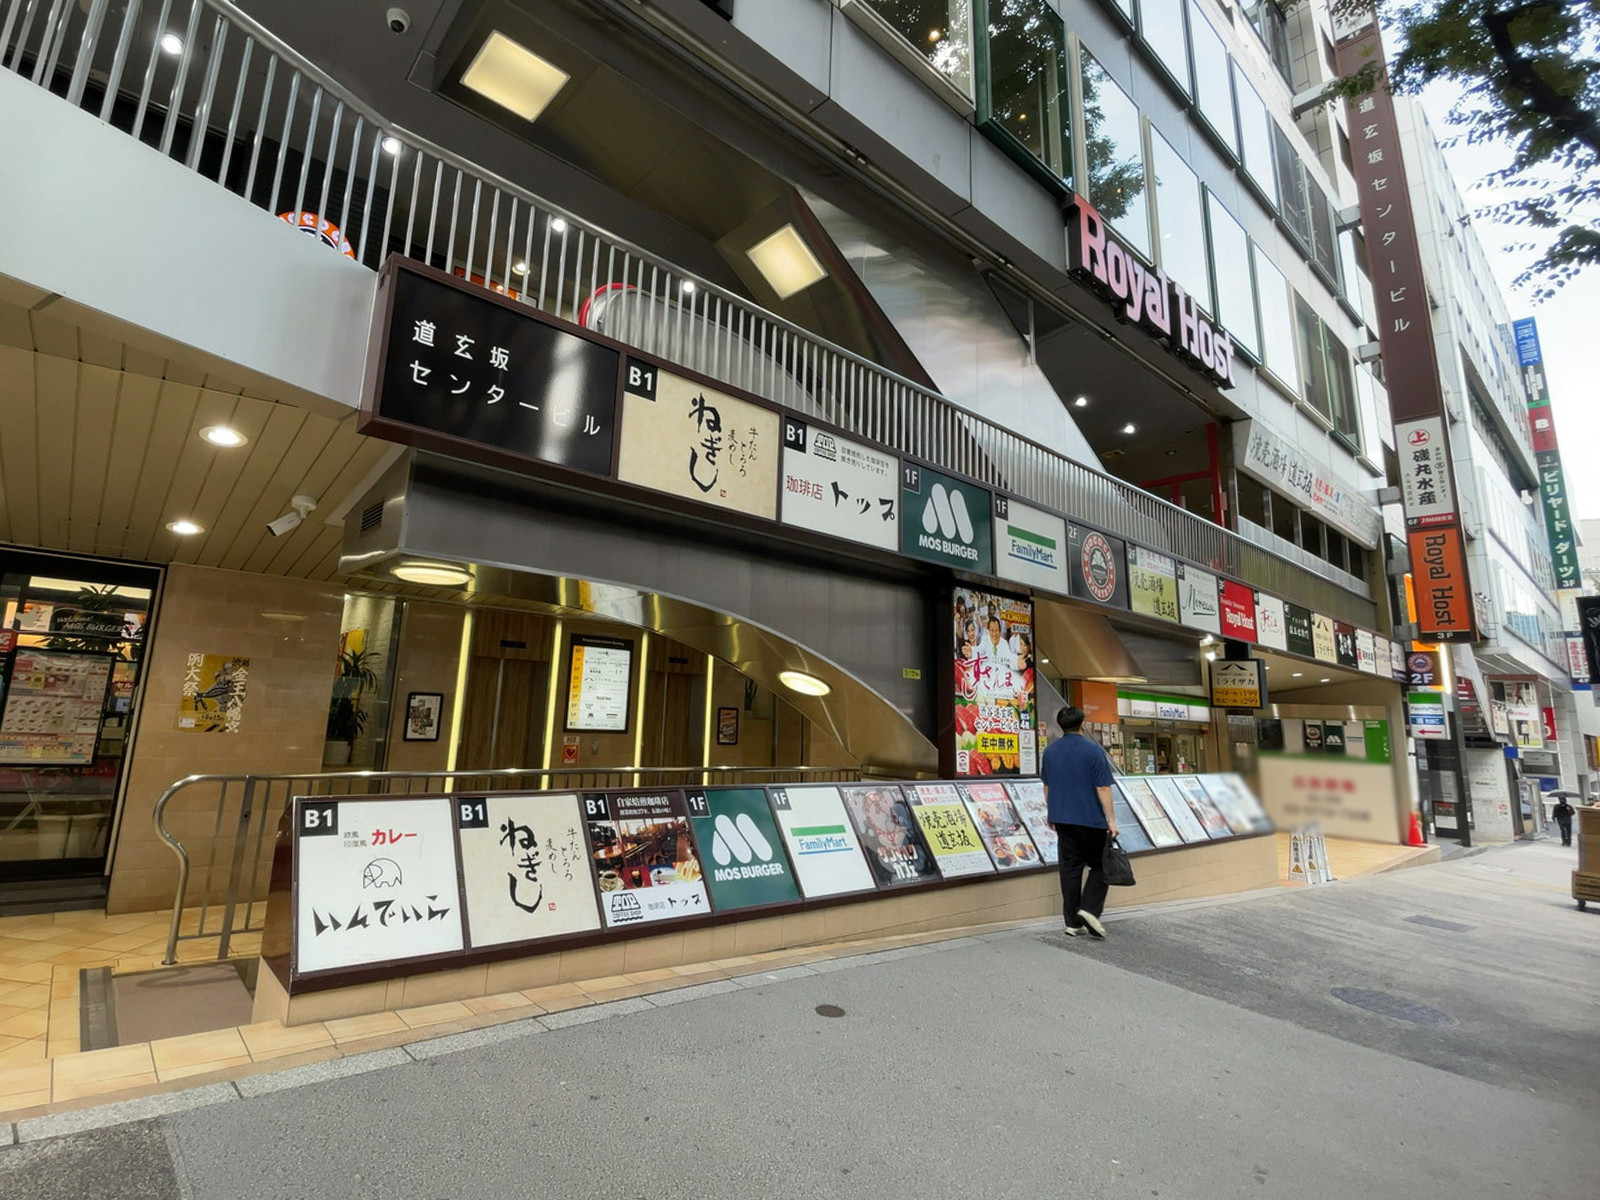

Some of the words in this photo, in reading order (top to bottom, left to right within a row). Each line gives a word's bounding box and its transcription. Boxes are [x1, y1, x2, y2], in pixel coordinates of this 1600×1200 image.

[1359, 97, 1410, 332] 道玄坂センタービル
[1074, 193, 1171, 336] Royal
[1175, 281, 1236, 389] Host
[412, 319, 511, 372] 道玄坂
[629, 365, 654, 392] B1
[409, 360, 601, 436] センタービル
[688, 393, 723, 493] ねぎし
[748, 427, 759, 461] 牛たん
[786, 424, 804, 445] B1
[1411, 430, 1427, 443] 上
[739, 441, 747, 477] とろろ
[905, 468, 918, 486] 1F
[1412, 448, 1437, 505] 磯丸水産
[786, 475, 823, 500] 珈琲店
[831, 481, 895, 521] トップ
[996, 499, 1007, 514] 1F
[1068, 525, 1078, 539] 2F
[919, 533, 942, 552] MOS
[942, 541, 979, 561] BURGER
[1011, 540, 1054, 563] FamilyMart
[1425, 533, 1452, 580] Royal
[1562, 579, 1576, 588] 3F
[1432, 586, 1456, 627] Host
[1437, 632, 1454, 640] 3F
[1216, 678, 1255, 686] ミライザカ
[1411, 673, 1434, 684] 2F
[1160, 706, 1186, 718] FamilyMart
[980, 736, 1014, 750] 年中無休
[586, 799, 605, 815] B1
[689, 797, 705, 811] 1F
[773, 793, 788, 805] 1F
[305, 809, 332, 828] B1
[461, 804, 484, 821] B1
[371, 828, 417, 846] カレー
[567, 828, 581, 860] 牛たん
[799, 837, 848, 851] FamilyMart
[935, 829, 975, 850] 道玄坂
[500, 816, 543, 913] ねぎし
[561, 846, 573, 881] とろろ
[714, 868, 741, 882] MOS
[742, 863, 784, 878] BURGER
[667, 893, 702, 908] トップ
[312, 894, 451, 937] いんでいら
